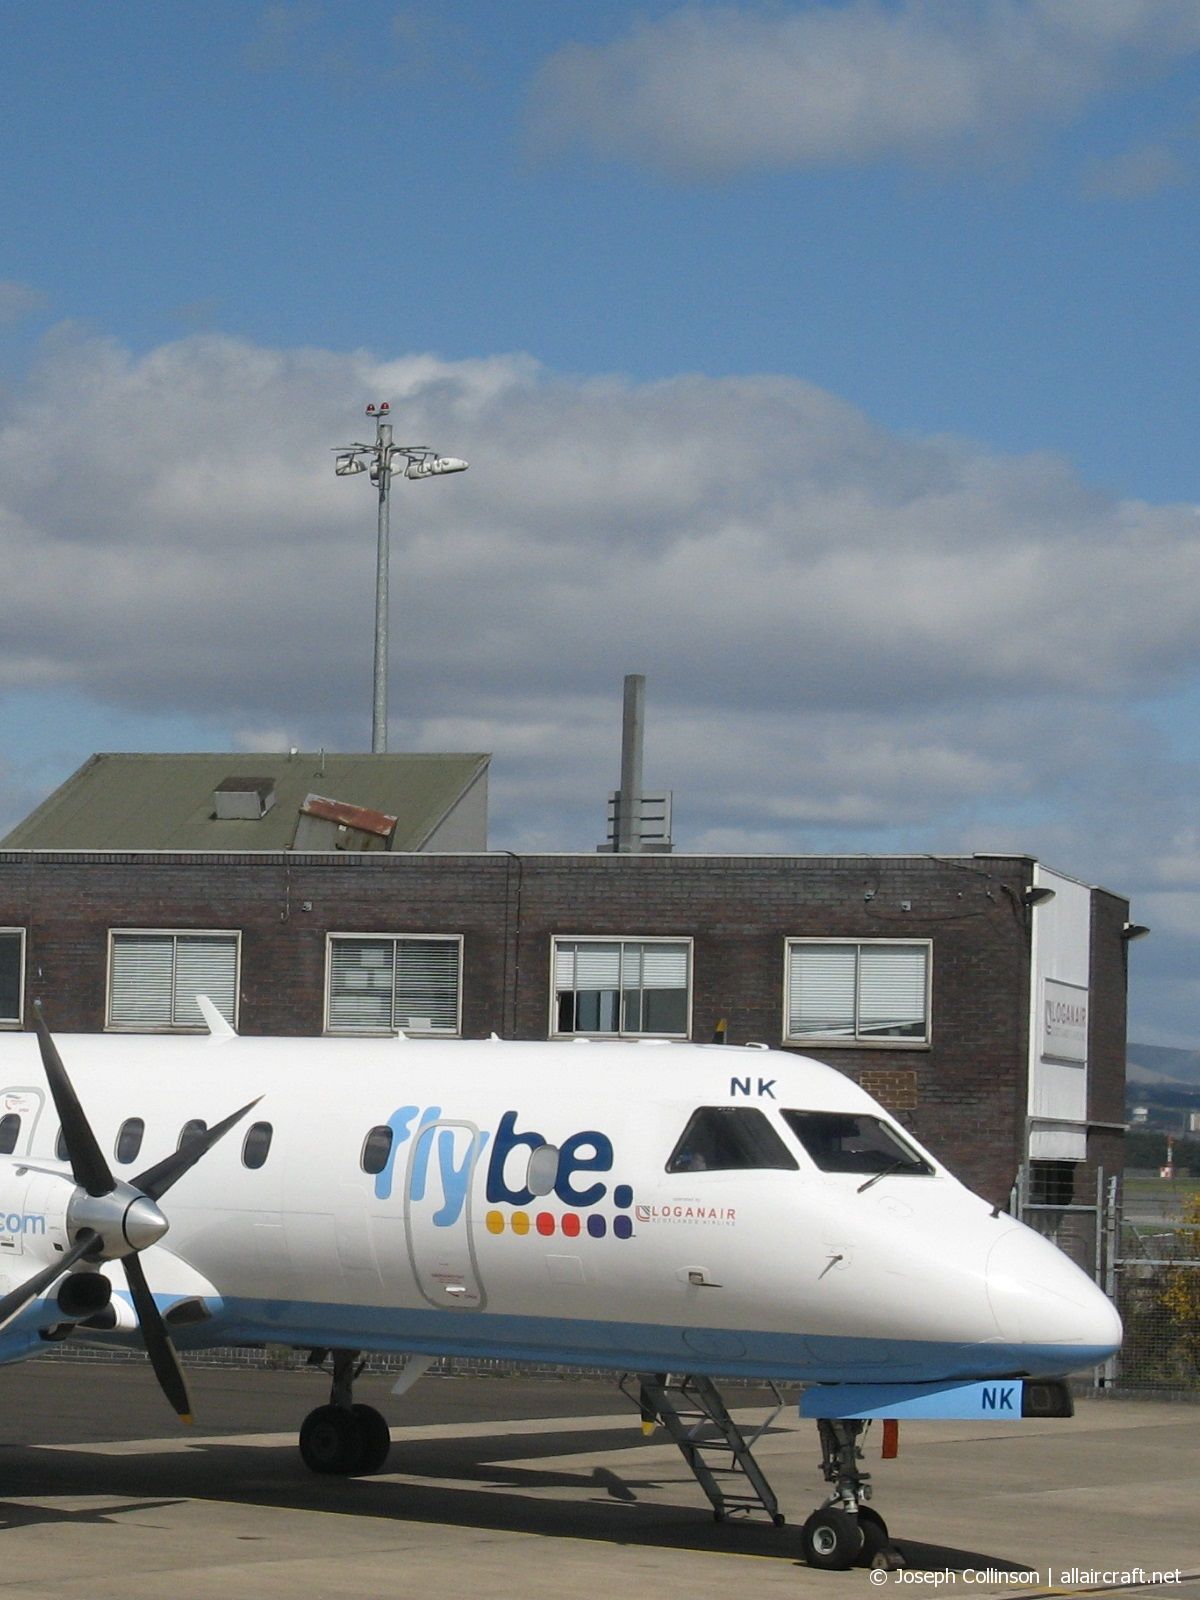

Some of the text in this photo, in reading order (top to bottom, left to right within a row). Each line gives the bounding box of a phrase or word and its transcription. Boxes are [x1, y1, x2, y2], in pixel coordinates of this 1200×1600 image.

[730, 1077, 777, 1100] NK
[652, 1206, 736, 1220] LOGANAIR
[982, 1387, 1014, 1410] NK
